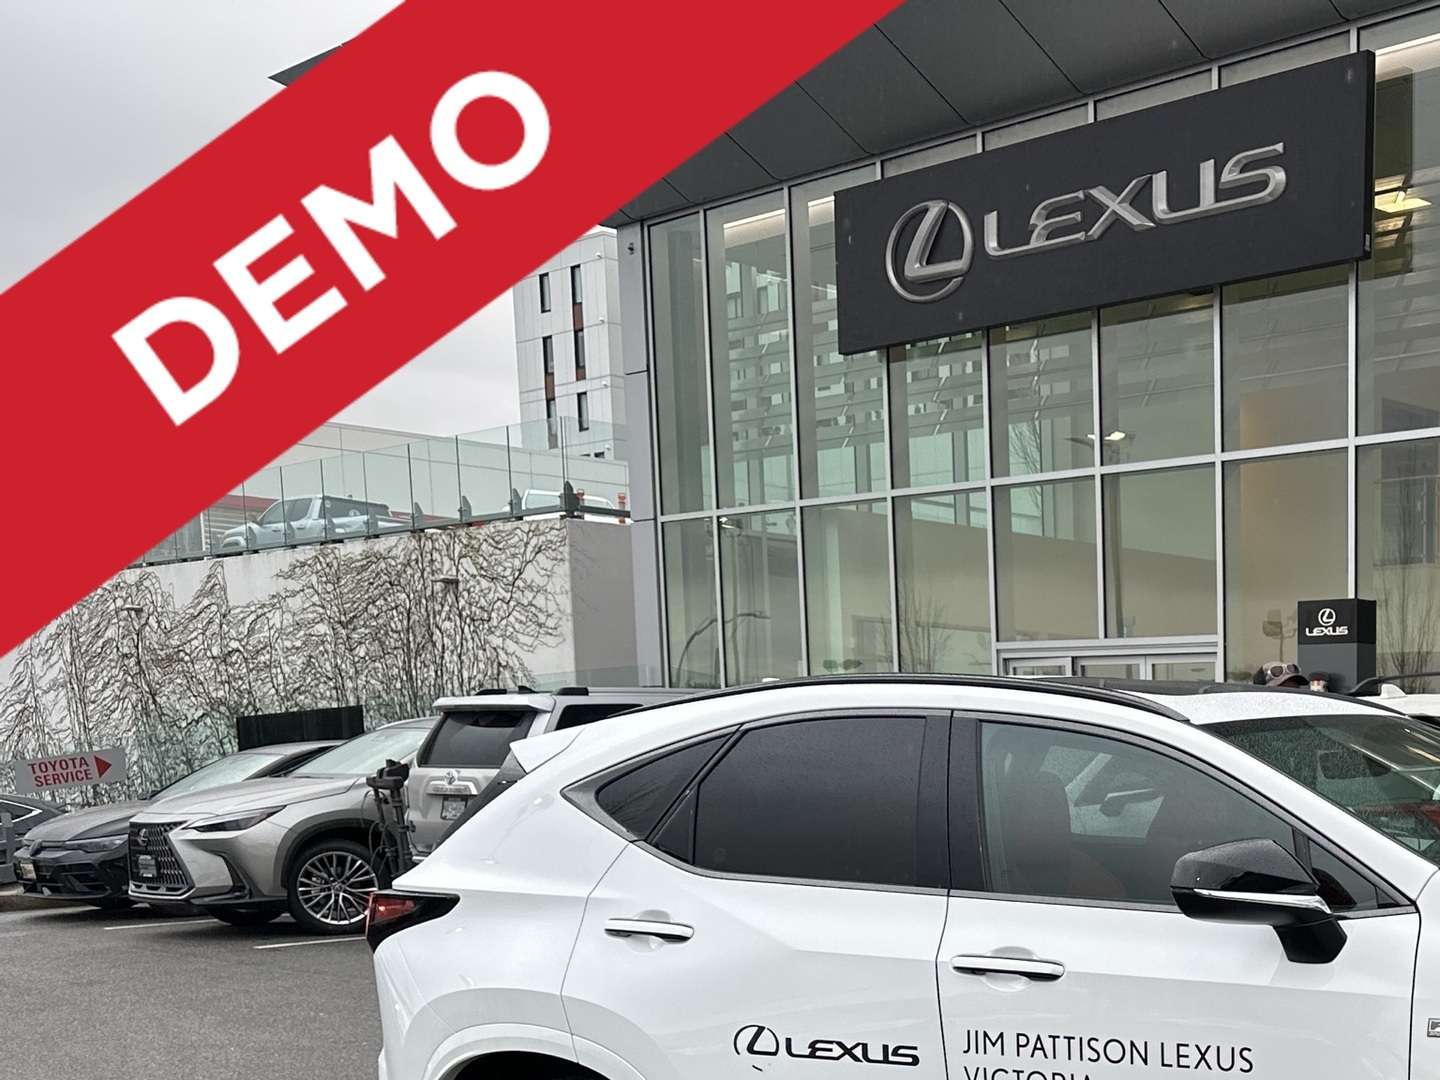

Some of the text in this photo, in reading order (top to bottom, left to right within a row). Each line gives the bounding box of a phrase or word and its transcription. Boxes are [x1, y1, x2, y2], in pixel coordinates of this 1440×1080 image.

[983, 142, 1287, 257] LEXUS
[1305, 626, 1349, 637] LEXUS
[28, 756, 90, 775] TOYOTA
[34, 768, 93, 787] SERVICE
[785, 1037, 920, 1067] LEXUS
[963, 1029, 1255, 1073] JIM PATTISON LEXUS
